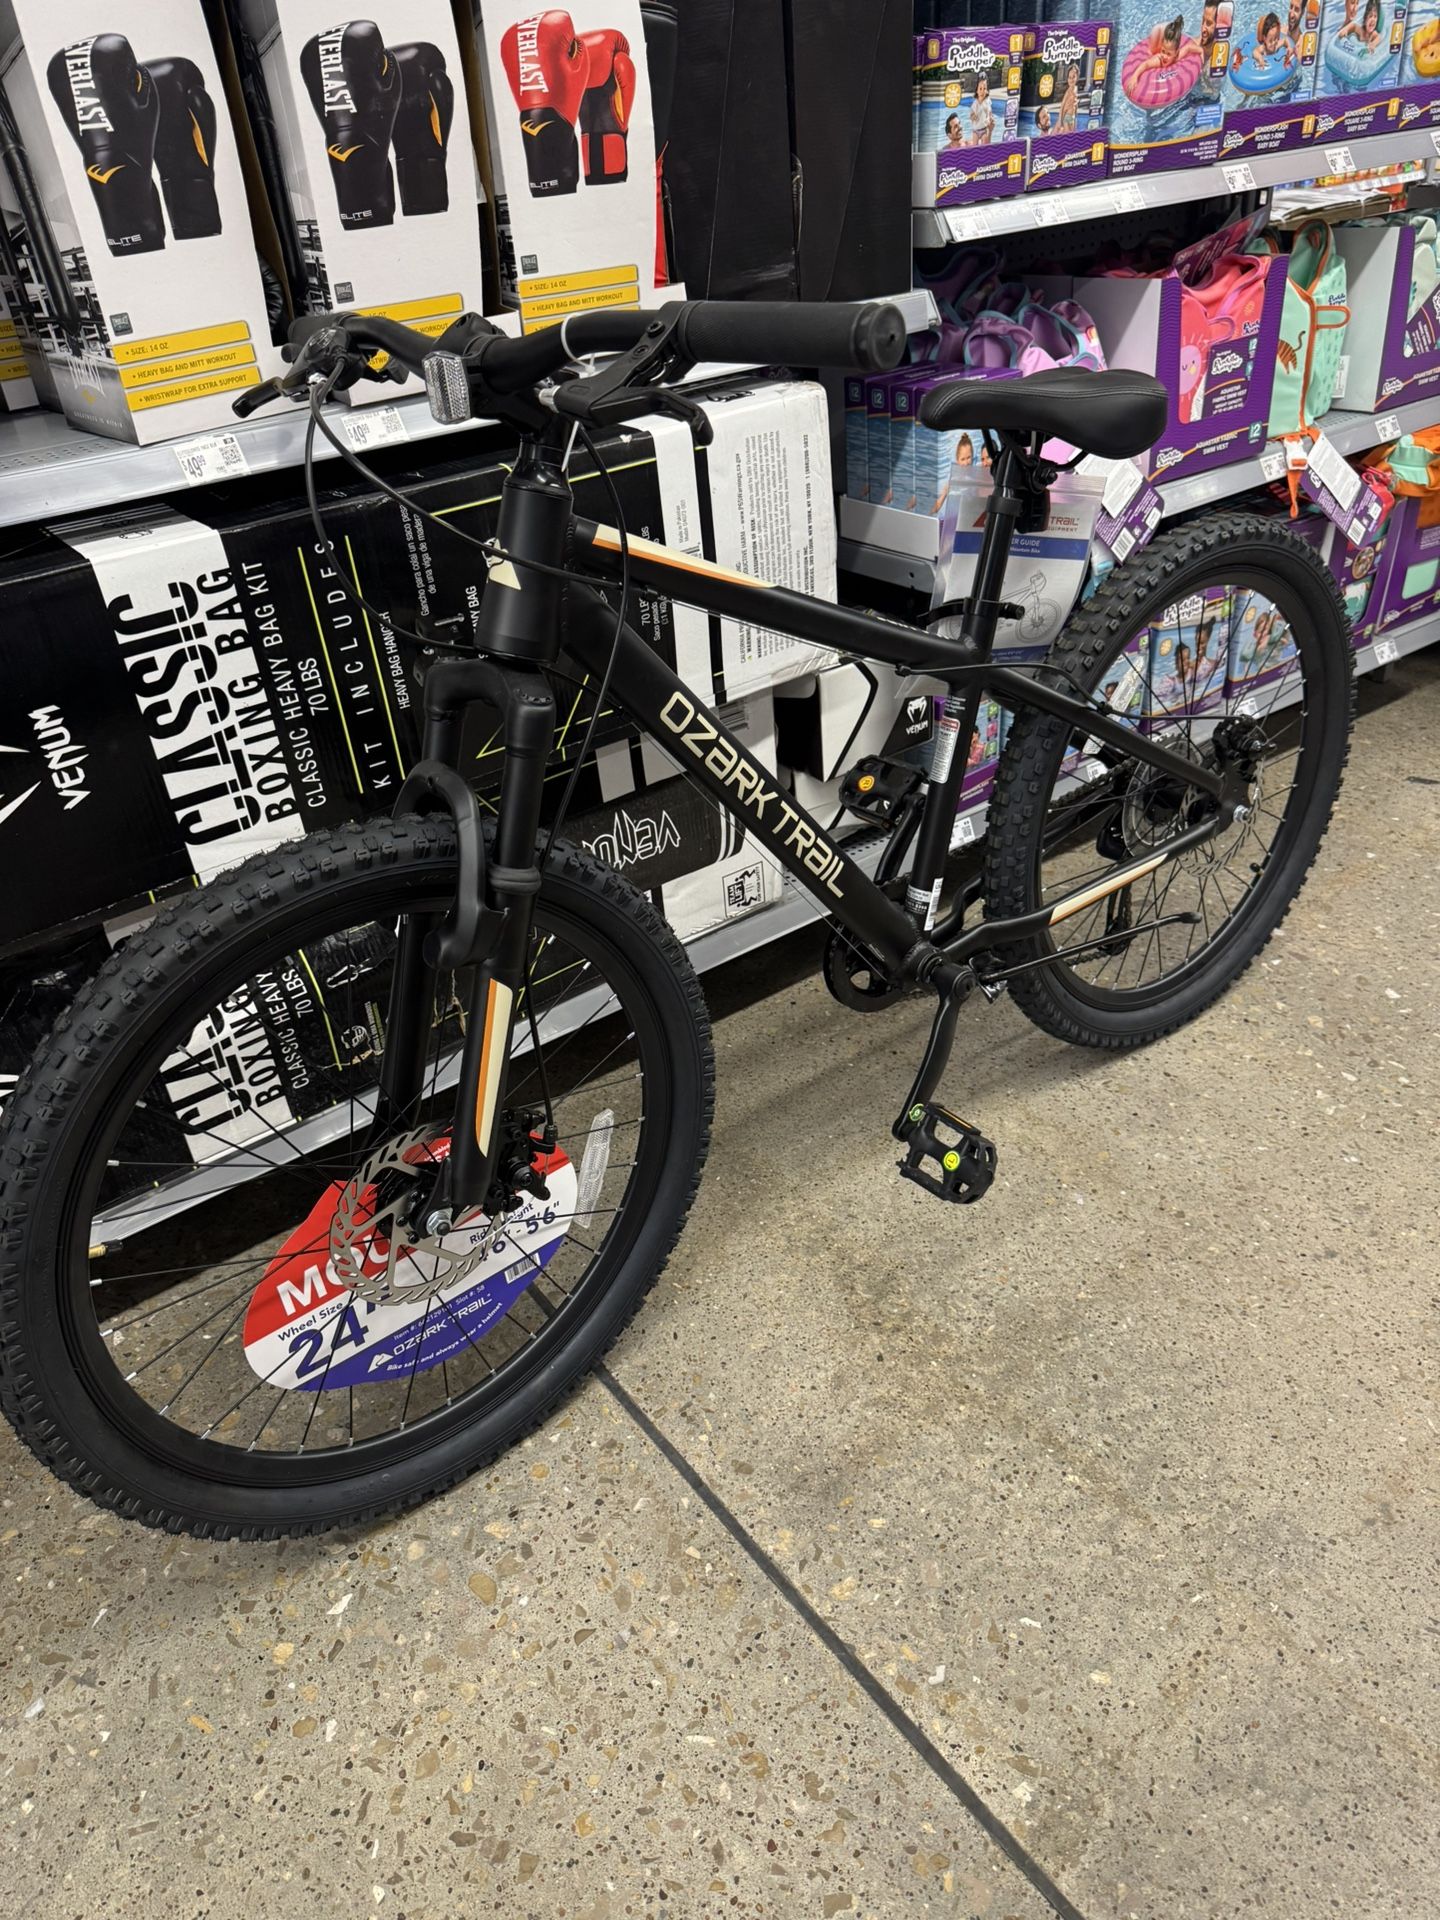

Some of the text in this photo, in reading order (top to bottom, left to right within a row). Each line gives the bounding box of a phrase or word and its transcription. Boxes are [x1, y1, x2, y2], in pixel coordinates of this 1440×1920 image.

[950, 45, 989, 60] Puddle
[1045, 38, 1079, 51] Puddle
[949, 55, 994, 71] Jumper
[1044, 48, 1083, 62] Jumper
[986, 171, 1003, 180] DIAPER
[534, 280, 568, 290] SIZE: 14 OZ
[537, 292, 623, 312] HEAVY BAG AND MITT WORKOUT
[420, 323, 448, 334] WORKOUT
[131, 342, 169, 356] SIZE: 14 OZ
[137, 352, 237, 379] HEAVY BAG AND MITT WORKOUT
[143, 374, 248, 403] WRISTWRAP FOR EXTRA SUPPORT
[404, 523, 414, 541] saco
[418, 542, 428, 552] de
[1020, 539, 1041, 547] GUIDE
[420, 552, 432, 568] viga
[413, 571, 425, 588] para
[424, 568, 435, 584] una
[427, 584, 437, 594] de
[465, 586, 480, 608] BAG
[418, 589, 430, 616] Gancho
[641, 613, 651, 626] 70
[388, 655, 403, 676] BAG
[241, 560, 327, 809] CLASSIC HEAVY BAG KIT
[297, 657, 329, 717] 70 LBS
[393, 679, 411, 709] HEAVY
[196, 567, 301, 824] BOXING BAG
[107, 581, 262, 847] CLASSIC
[905, 720, 929, 735] VENUM
[27, 704, 92, 811] VENUM
[659, 691, 845, 899] OZARK TRAIL
[281, 969, 314, 1019] 70 LBS
[256, 970, 310, 1090] CLASSIC HEAVY
[277, 1302, 344, 1342] Wheel Size
[393, 1329, 410, 1341] Item
[455, 1295, 469, 1305] Slot
[393, 1296, 493, 1356] OZARK TRAIL
[386, 1363, 403, 1371] Bike
[420, 1351, 434, 1363] and
[435, 1339, 460, 1358] always
[481, 1301, 503, 1325] helmet
